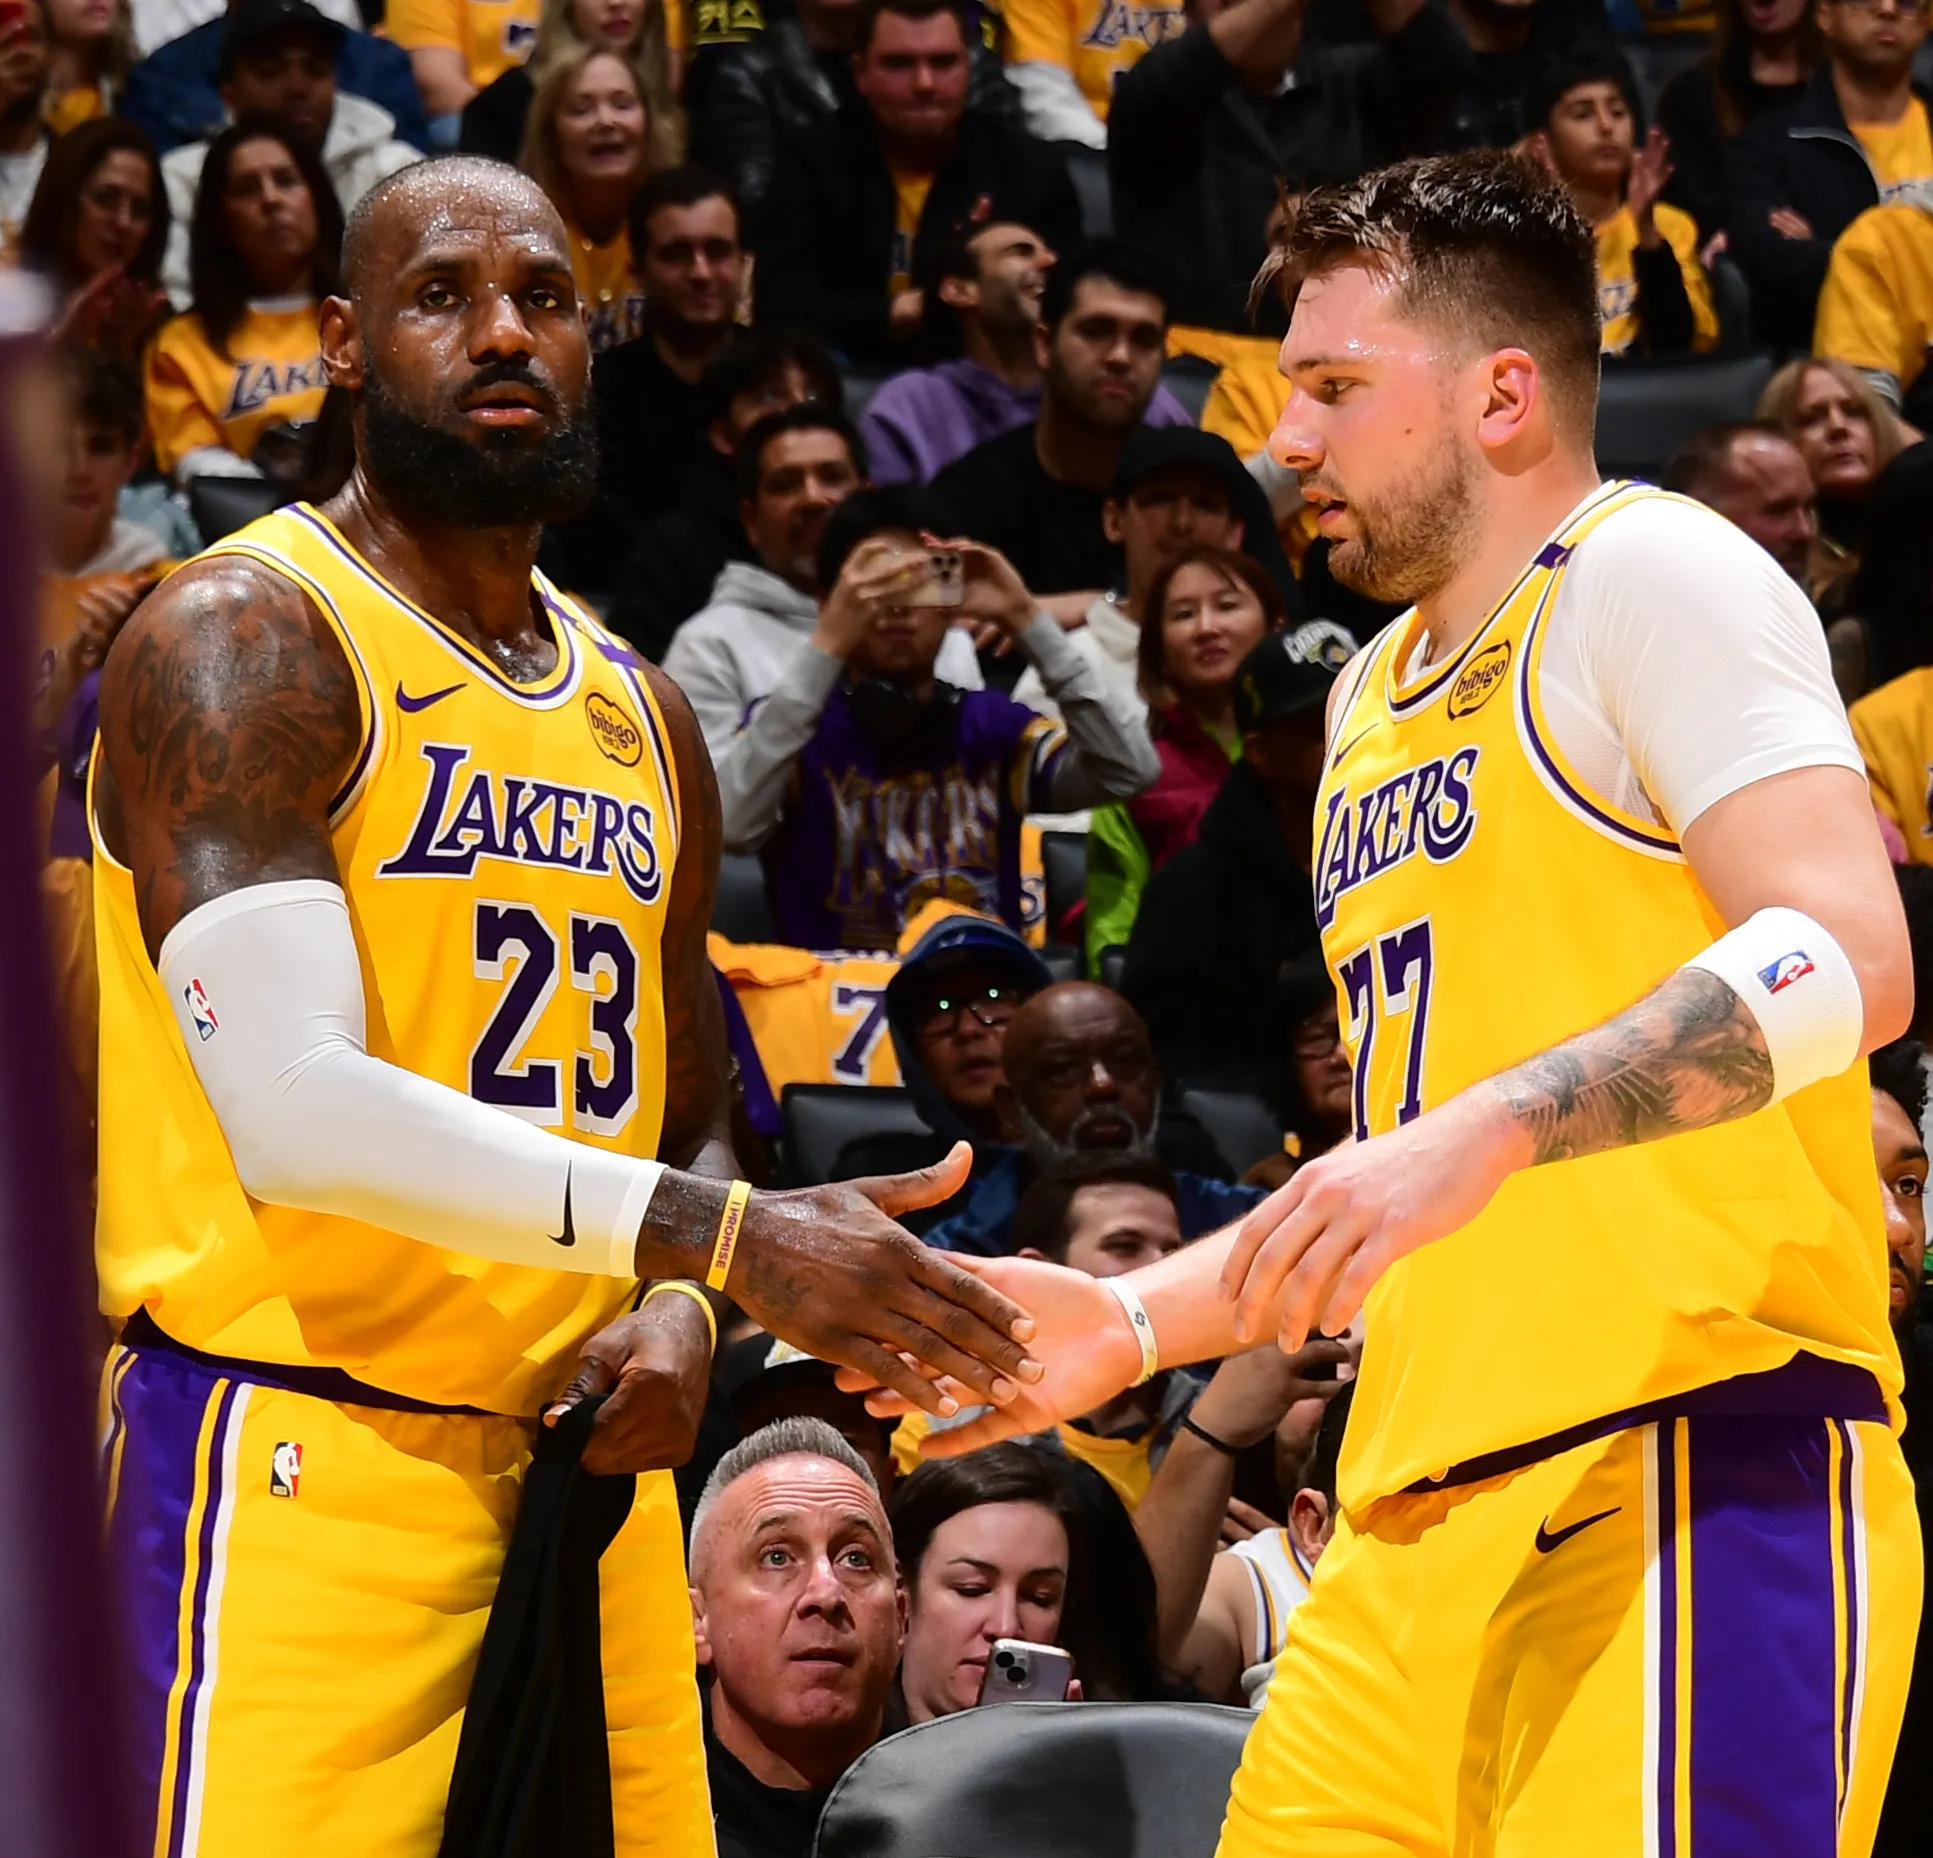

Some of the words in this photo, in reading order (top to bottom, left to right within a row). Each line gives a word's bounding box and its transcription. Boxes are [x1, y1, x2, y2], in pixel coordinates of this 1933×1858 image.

[588, 706, 637, 750] bibigo
[1455, 660, 1506, 697] bibigo
[374, 740, 663, 906] LAKERS
[1314, 744, 1481, 935] LAKERS
[468, 898, 639, 1137] 23
[1334, 913, 1434, 1144] 77
[715, 1207, 740, 1269] PROMISE
